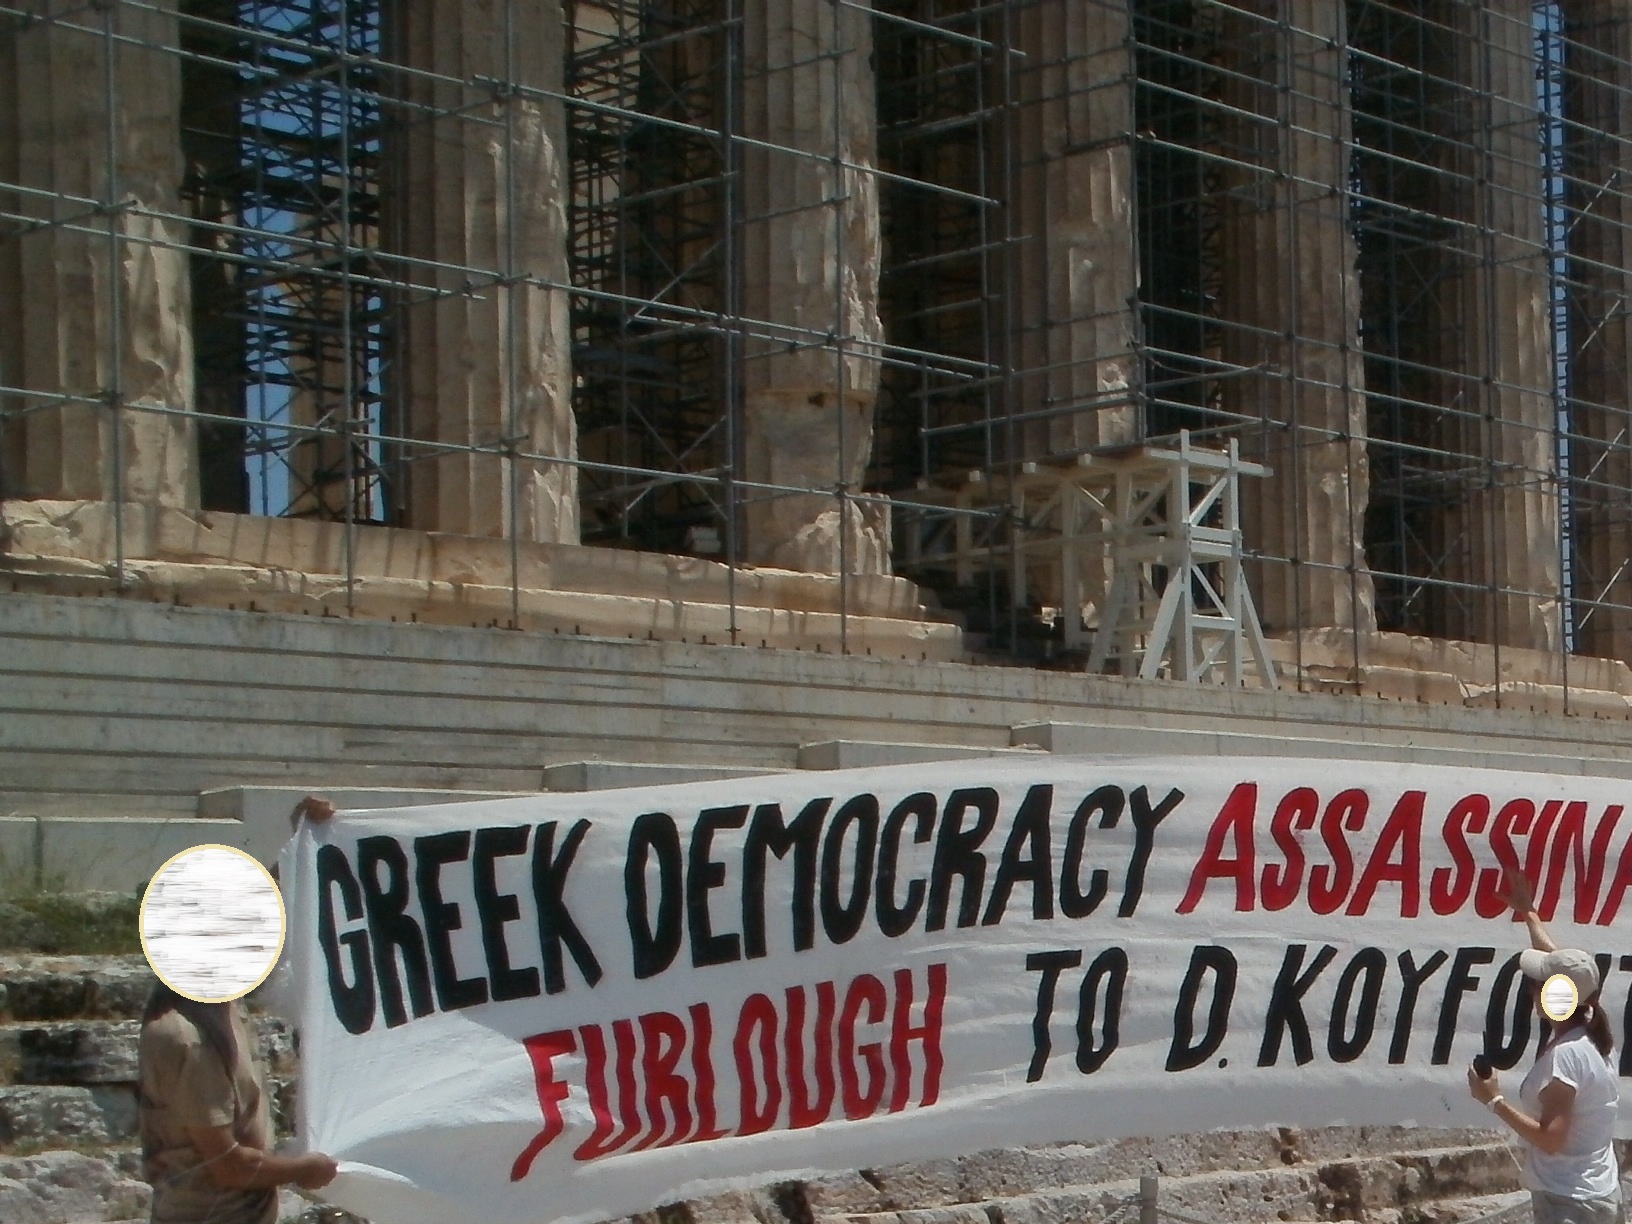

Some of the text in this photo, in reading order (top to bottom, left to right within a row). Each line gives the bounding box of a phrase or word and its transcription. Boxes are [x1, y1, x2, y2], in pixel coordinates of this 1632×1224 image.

[316, 818, 604, 1035] GREEK
[624, 784, 1186, 980] DEMOCRACY
[510, 963, 948, 1183] FURLOUGH
[1025, 947, 1129, 1084] TO
